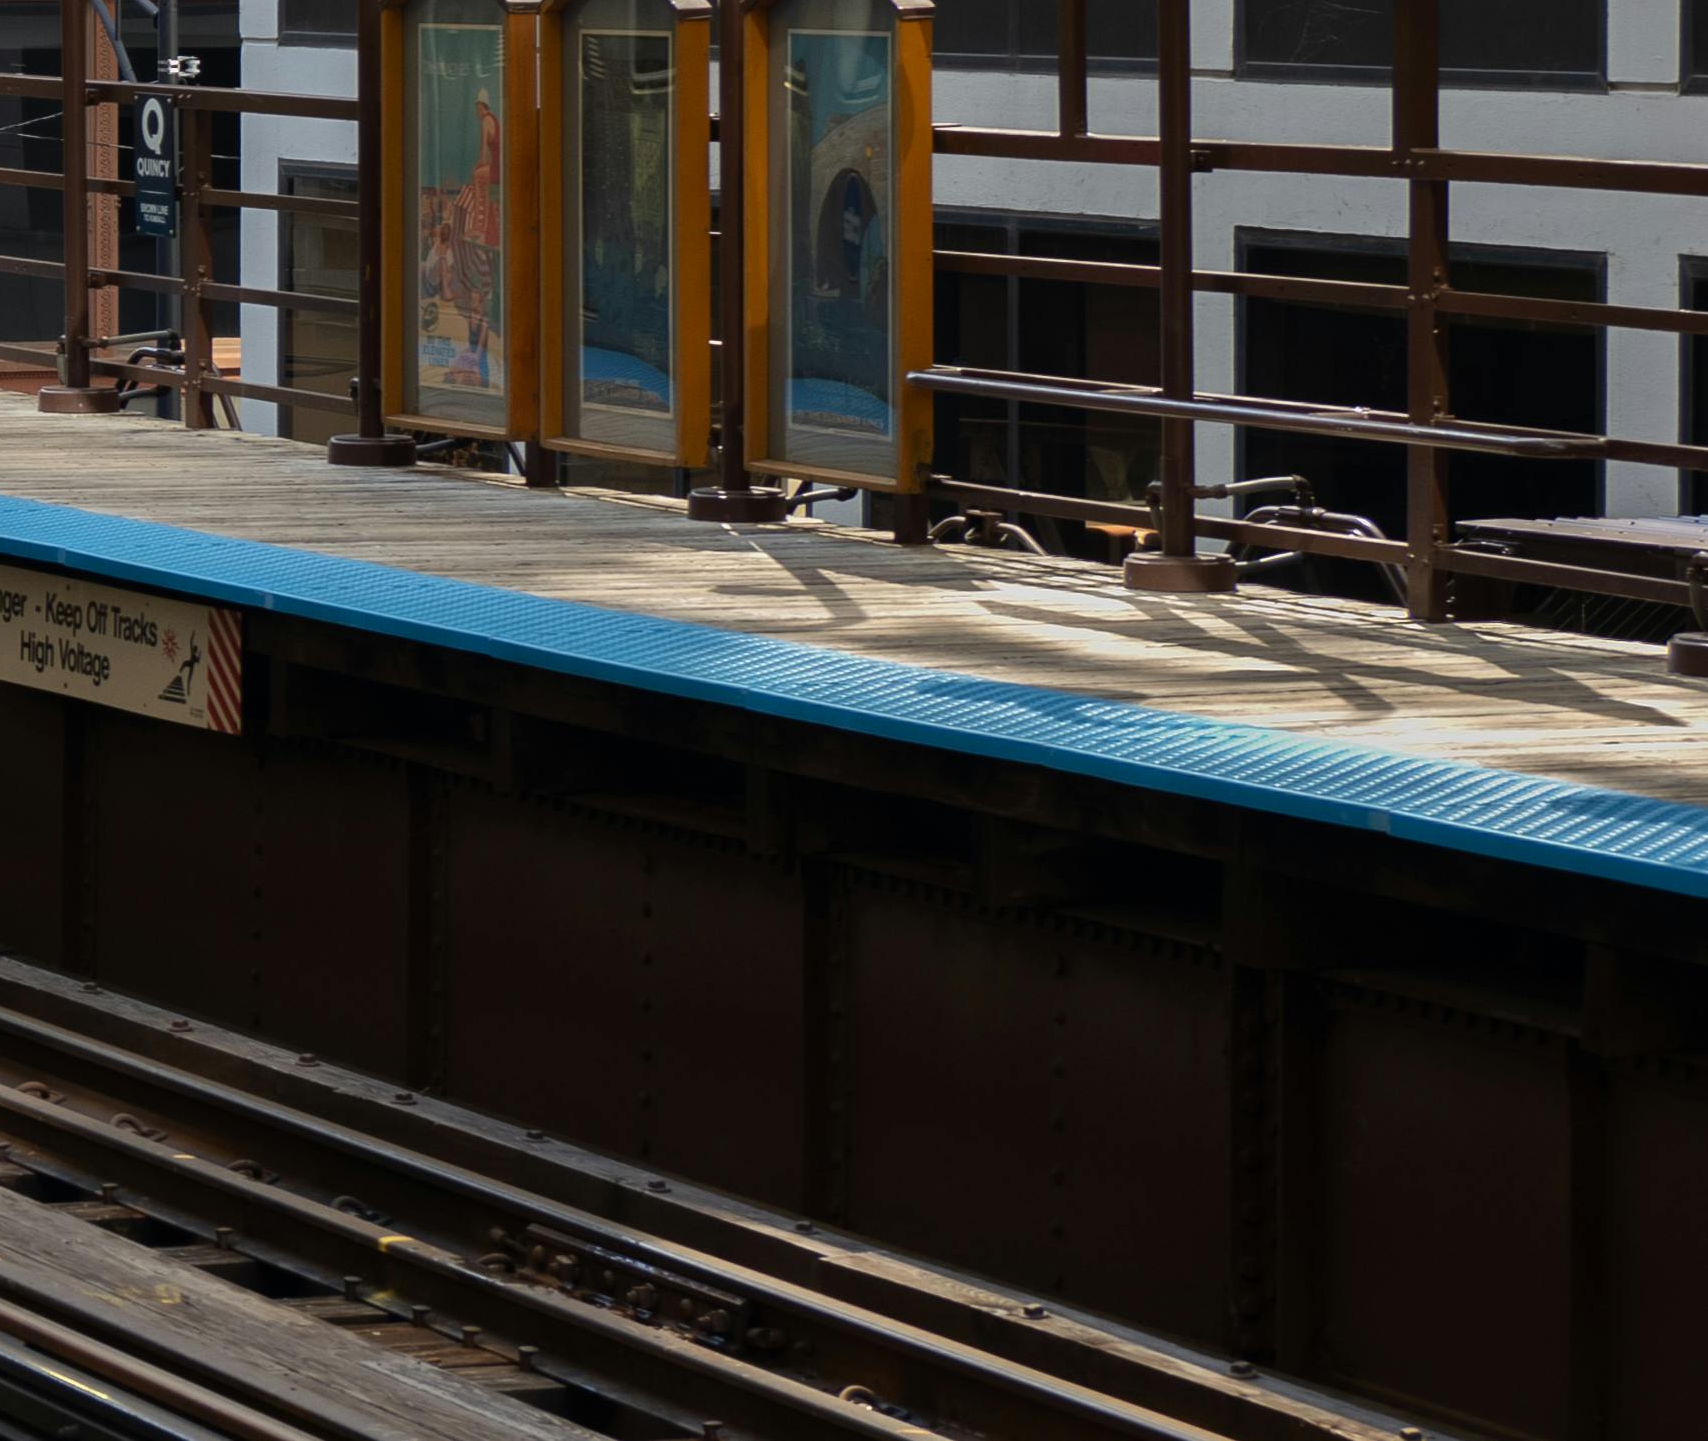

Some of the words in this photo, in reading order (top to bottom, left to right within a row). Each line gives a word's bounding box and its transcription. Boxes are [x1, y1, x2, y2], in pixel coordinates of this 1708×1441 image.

[142, 97, 164, 155] Q
[137, 157, 170, 178] QUINCY
[45, 591, 83, 637] Keep
[86, 600, 108, 635] Off
[111, 605, 158, 648] Tracks
[20, 630, 55, 673] High
[58, 637, 111, 686] Voltage
